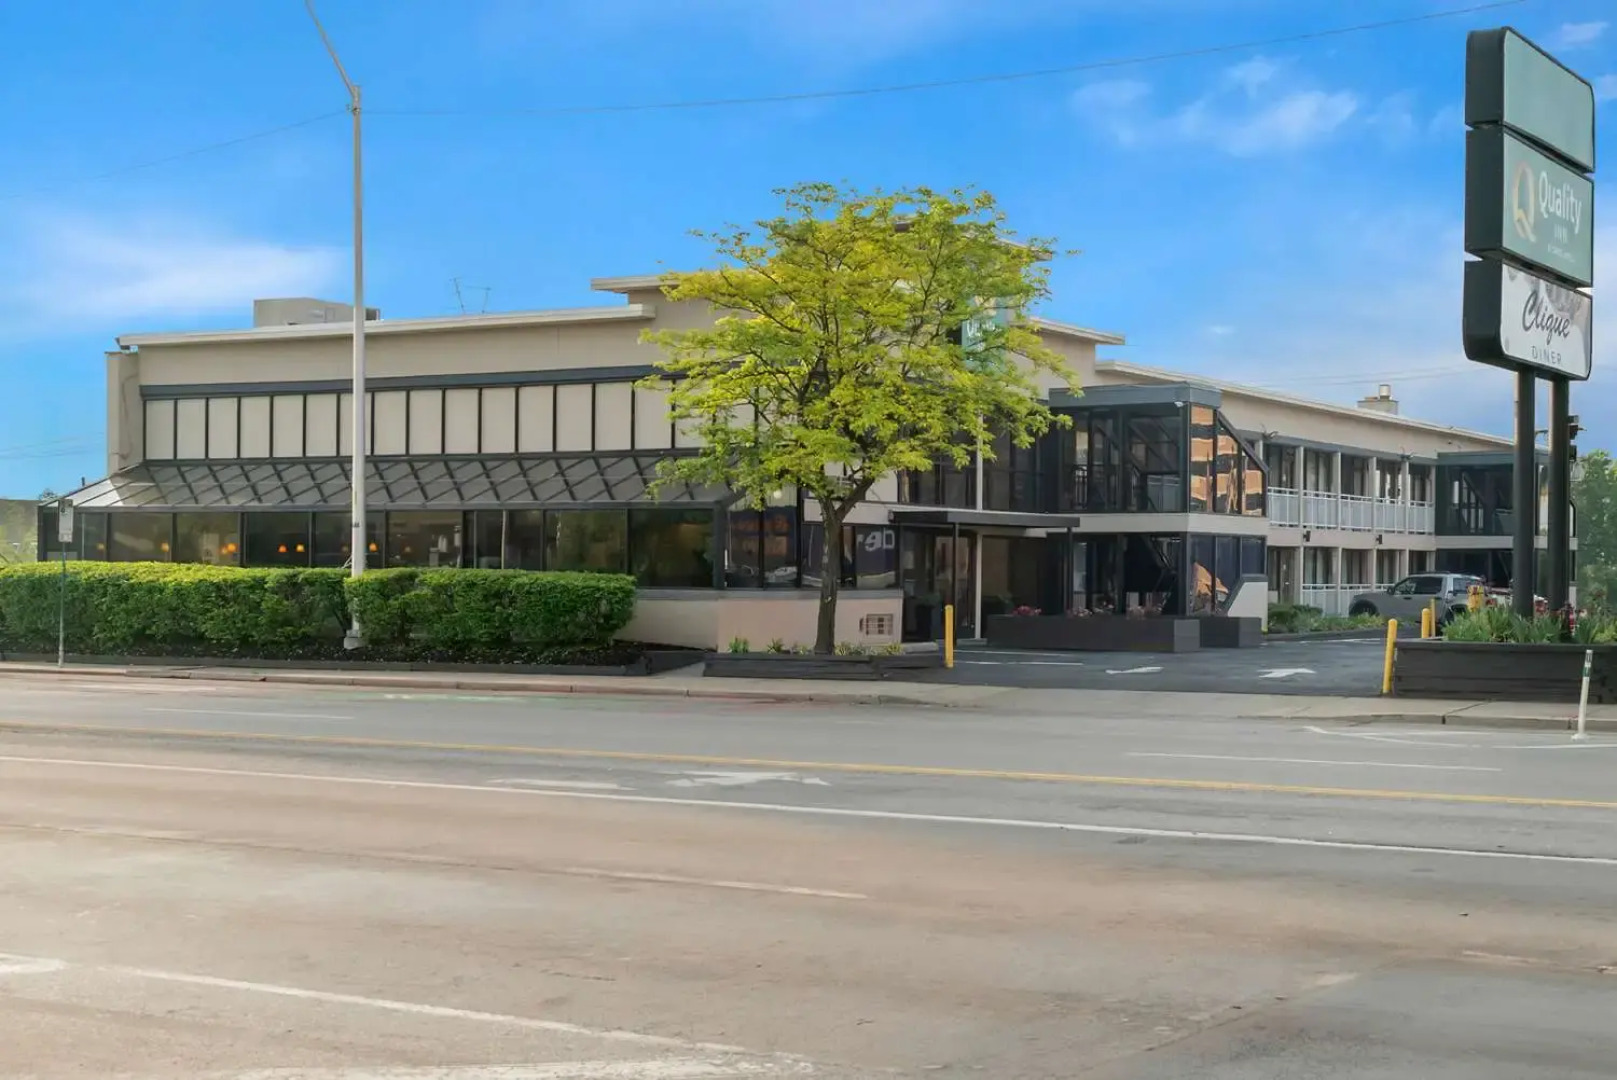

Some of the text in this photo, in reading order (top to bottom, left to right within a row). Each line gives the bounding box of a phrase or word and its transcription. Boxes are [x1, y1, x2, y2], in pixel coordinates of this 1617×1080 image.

[1538, 170, 1582, 234] Quality
[1522, 290, 1570, 345] Clique
[1531, 345, 1562, 365] DINER
